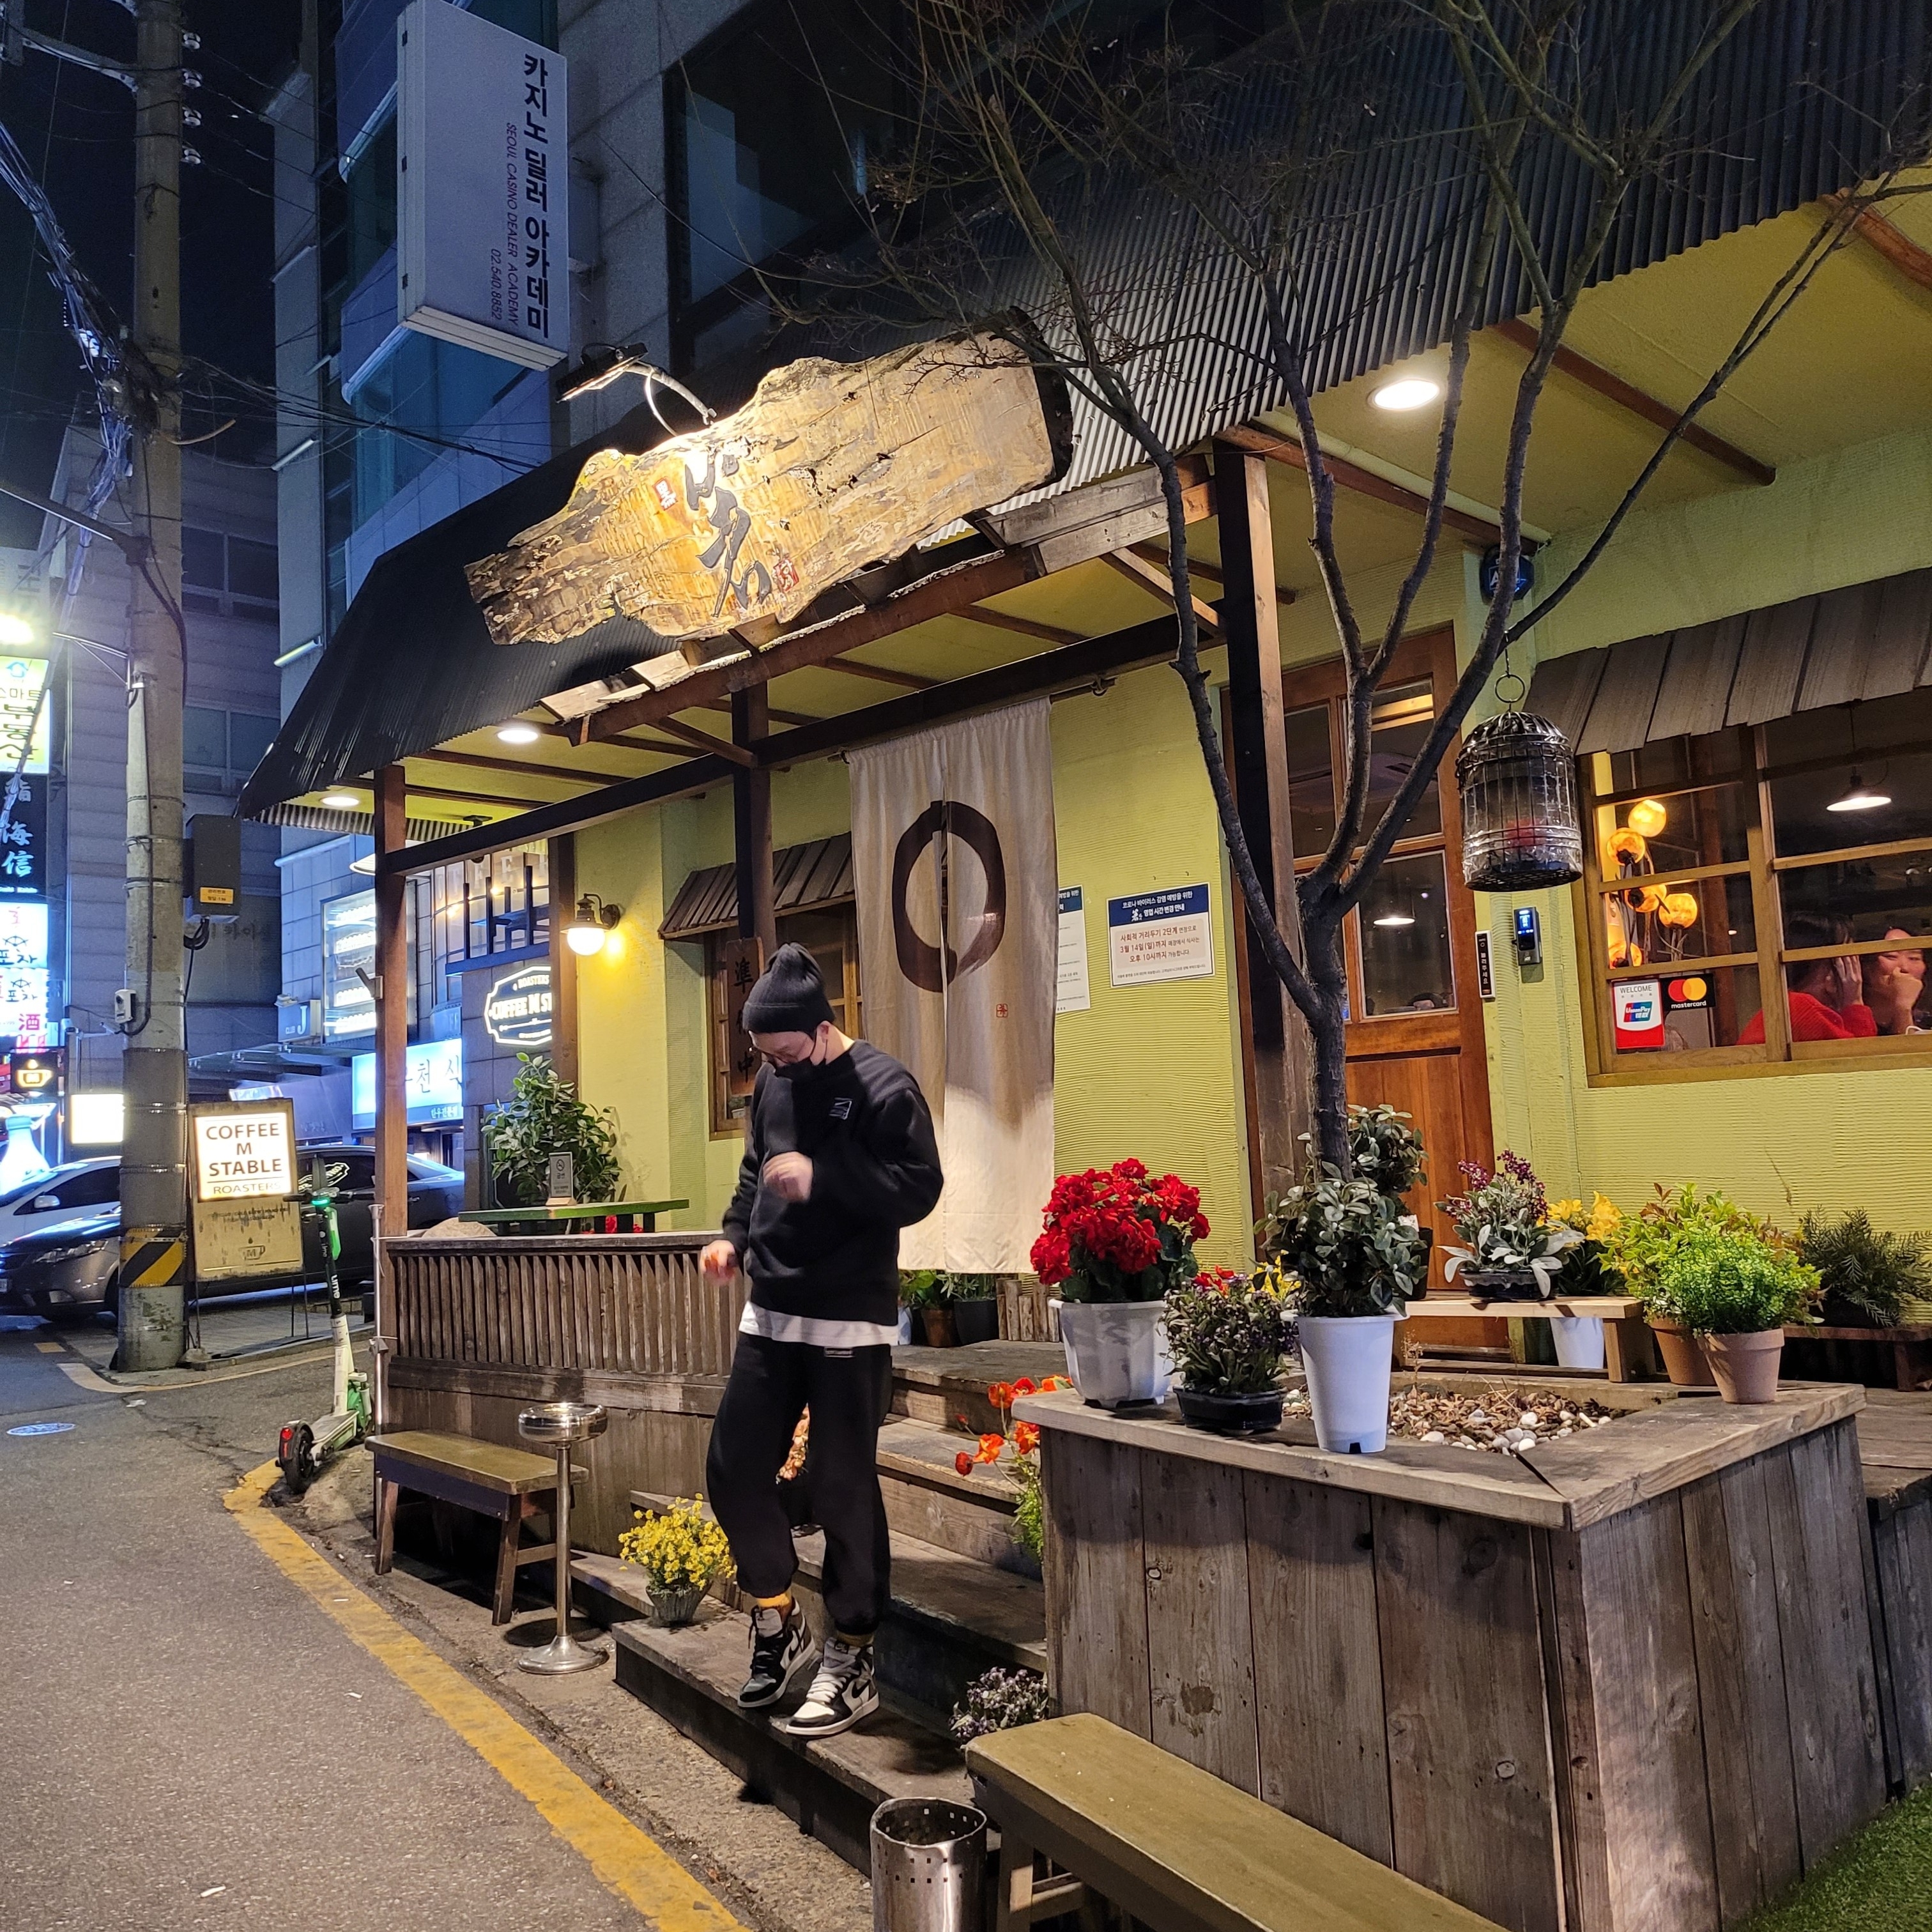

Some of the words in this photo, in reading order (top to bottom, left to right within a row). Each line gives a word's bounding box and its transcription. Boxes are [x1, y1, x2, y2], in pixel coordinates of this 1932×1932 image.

[524, 54, 548, 144] 카지노
[506, 123, 517, 158] SEOUL
[506, 163, 518, 210] CASINO
[525, 148, 548, 212] 딜러
[507, 212, 519, 257] DEALER
[491, 249, 502, 320] 02.540.8852
[525, 217, 549, 339] 아카데미
[508, 262, 520, 326] ACADEMY
[1122, 900, 1137, 908] 코로나
[1137, 898, 1156, 907] 바이러스
[1167, 893, 1182, 901] 예방을
[1182, 891, 1193, 900] 위한
[1144, 908, 1154, 917] 영업
[1154, 907, 1164, 916] 시간
[1164, 905, 1174, 914] 변경
[1174, 903, 1185, 912] 안내
[1120, 932, 1137, 942] 사회적
[1138, 929, 1162, 940] 거리두기
[1162, 926, 1178, 936] 2단계
[1179, 924, 1197, 933] 연장으로
[1120, 945, 1130, 953] 3월
[1131, 940, 1167, 953] 14일(일)까지
[1130, 954, 1141, 963] 오후
[1143, 951, 1167, 961] 10시까지
[1620, 985, 1652, 994] WELCOME
[491, 997, 528, 1020] COFFEE
[1625, 1006, 1651, 1015] UnionPay
[1671, 1000, 1706, 1009] mastercard
[18, 1013, 42, 1031] 酒
[297, 1005, 308, 1035] J
[206, 1123, 280, 1140] COFFEE
[236, 1142, 252, 1155] M
[209, 1158, 282, 1177] STABLE
[213, 1182, 282, 1195] ROASTERS
